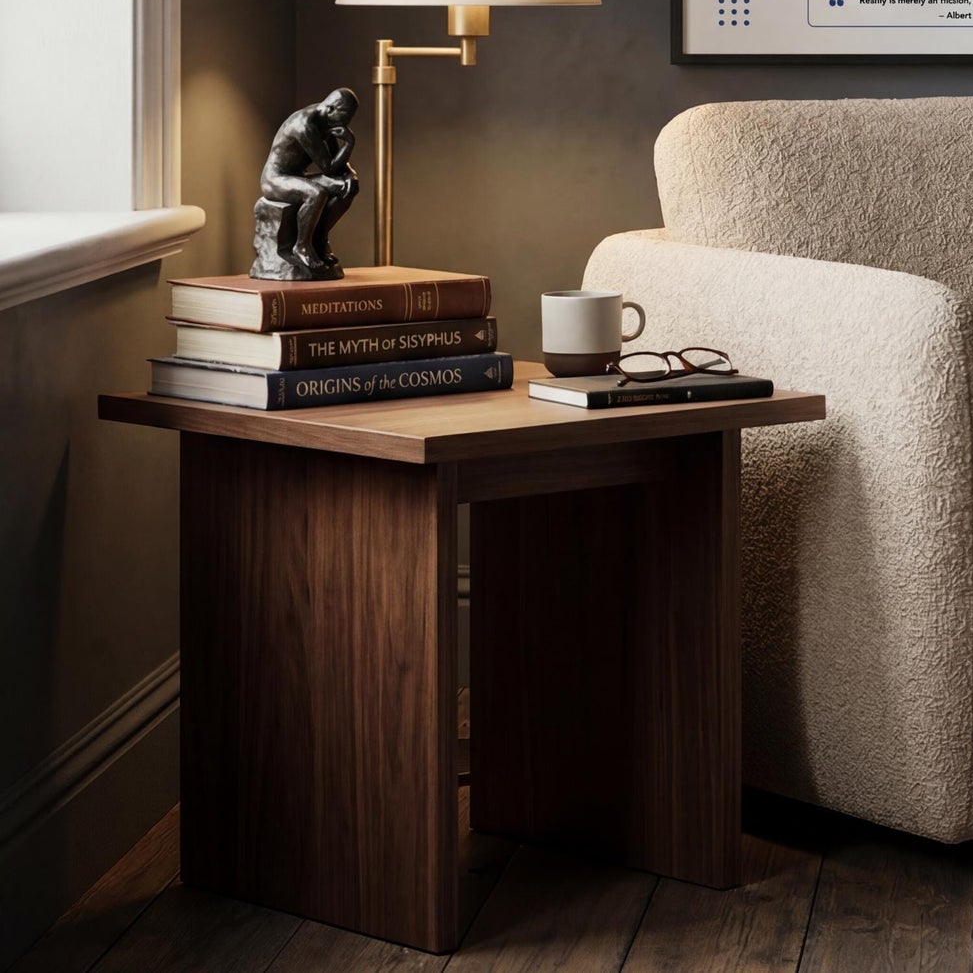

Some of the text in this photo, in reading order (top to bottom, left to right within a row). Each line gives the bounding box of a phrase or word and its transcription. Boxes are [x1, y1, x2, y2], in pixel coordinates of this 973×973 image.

[946, 11, 972, 20] Albert
[301, 299, 384, 316] MEDITATIONS
[308, 342, 336, 357] THE
[339, 338, 379, 354] MYTH
[399, 330, 462, 350] SISYPHUS
[296, 377, 361, 397] ORIGINS
[364, 374, 378, 396] of
[379, 373, 396, 390] the
[398, 368, 463, 388] COSMOS
